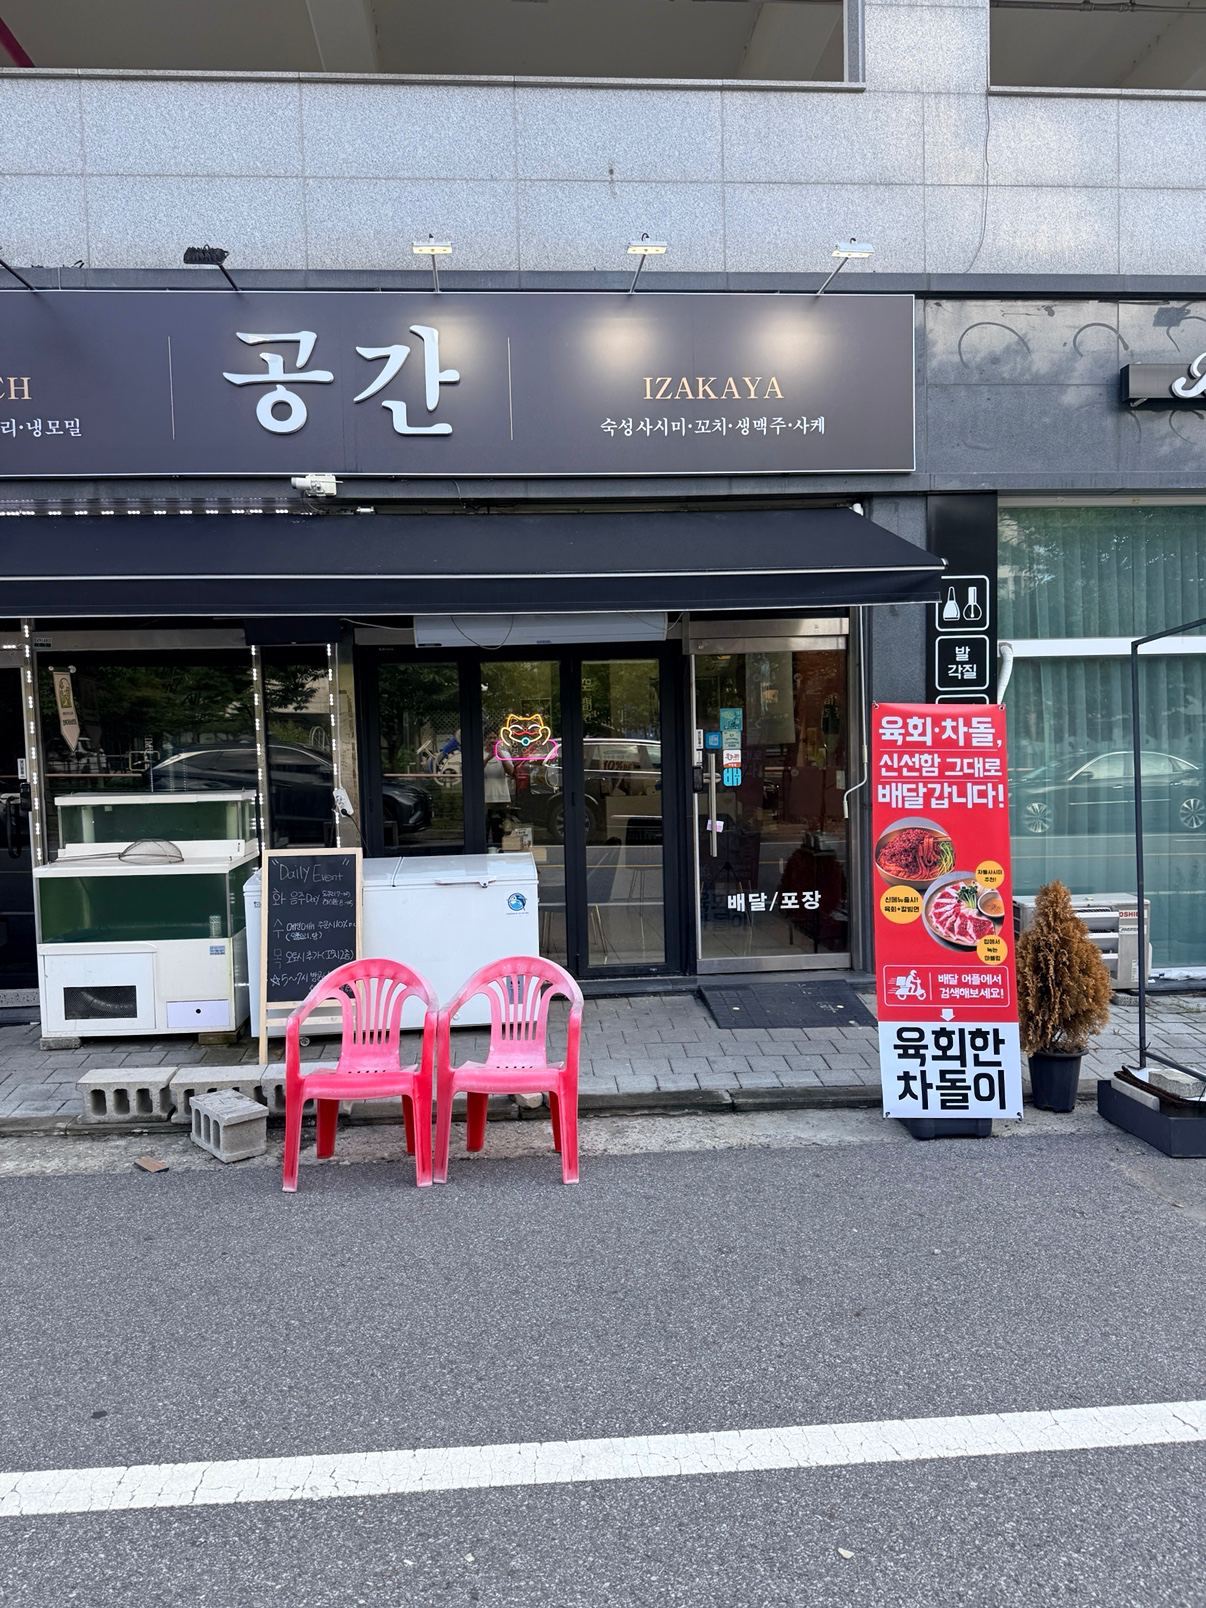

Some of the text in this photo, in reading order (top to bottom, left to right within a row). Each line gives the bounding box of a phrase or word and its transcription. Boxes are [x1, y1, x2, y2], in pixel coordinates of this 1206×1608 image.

[222, 324, 461, 436] 공간
[643, 376, 785, 400] IZAKAYA
[954, 645, 971, 661] 발
[947, 664, 978, 680] 각질
[878, 716, 1003, 748] 육회·차돌,
[879, 753, 1003, 777] 신선함 그대로
[272, 887, 287, 906] 화
[727, 890, 822, 912] 배달/포장
[938, 973, 1002, 985] 배달 어플에서
[939, 988, 1004, 999] 검색해보세요!
[893, 1026, 1006, 1068] 육회한
[896, 1069, 1007, 1110] 차돌이
